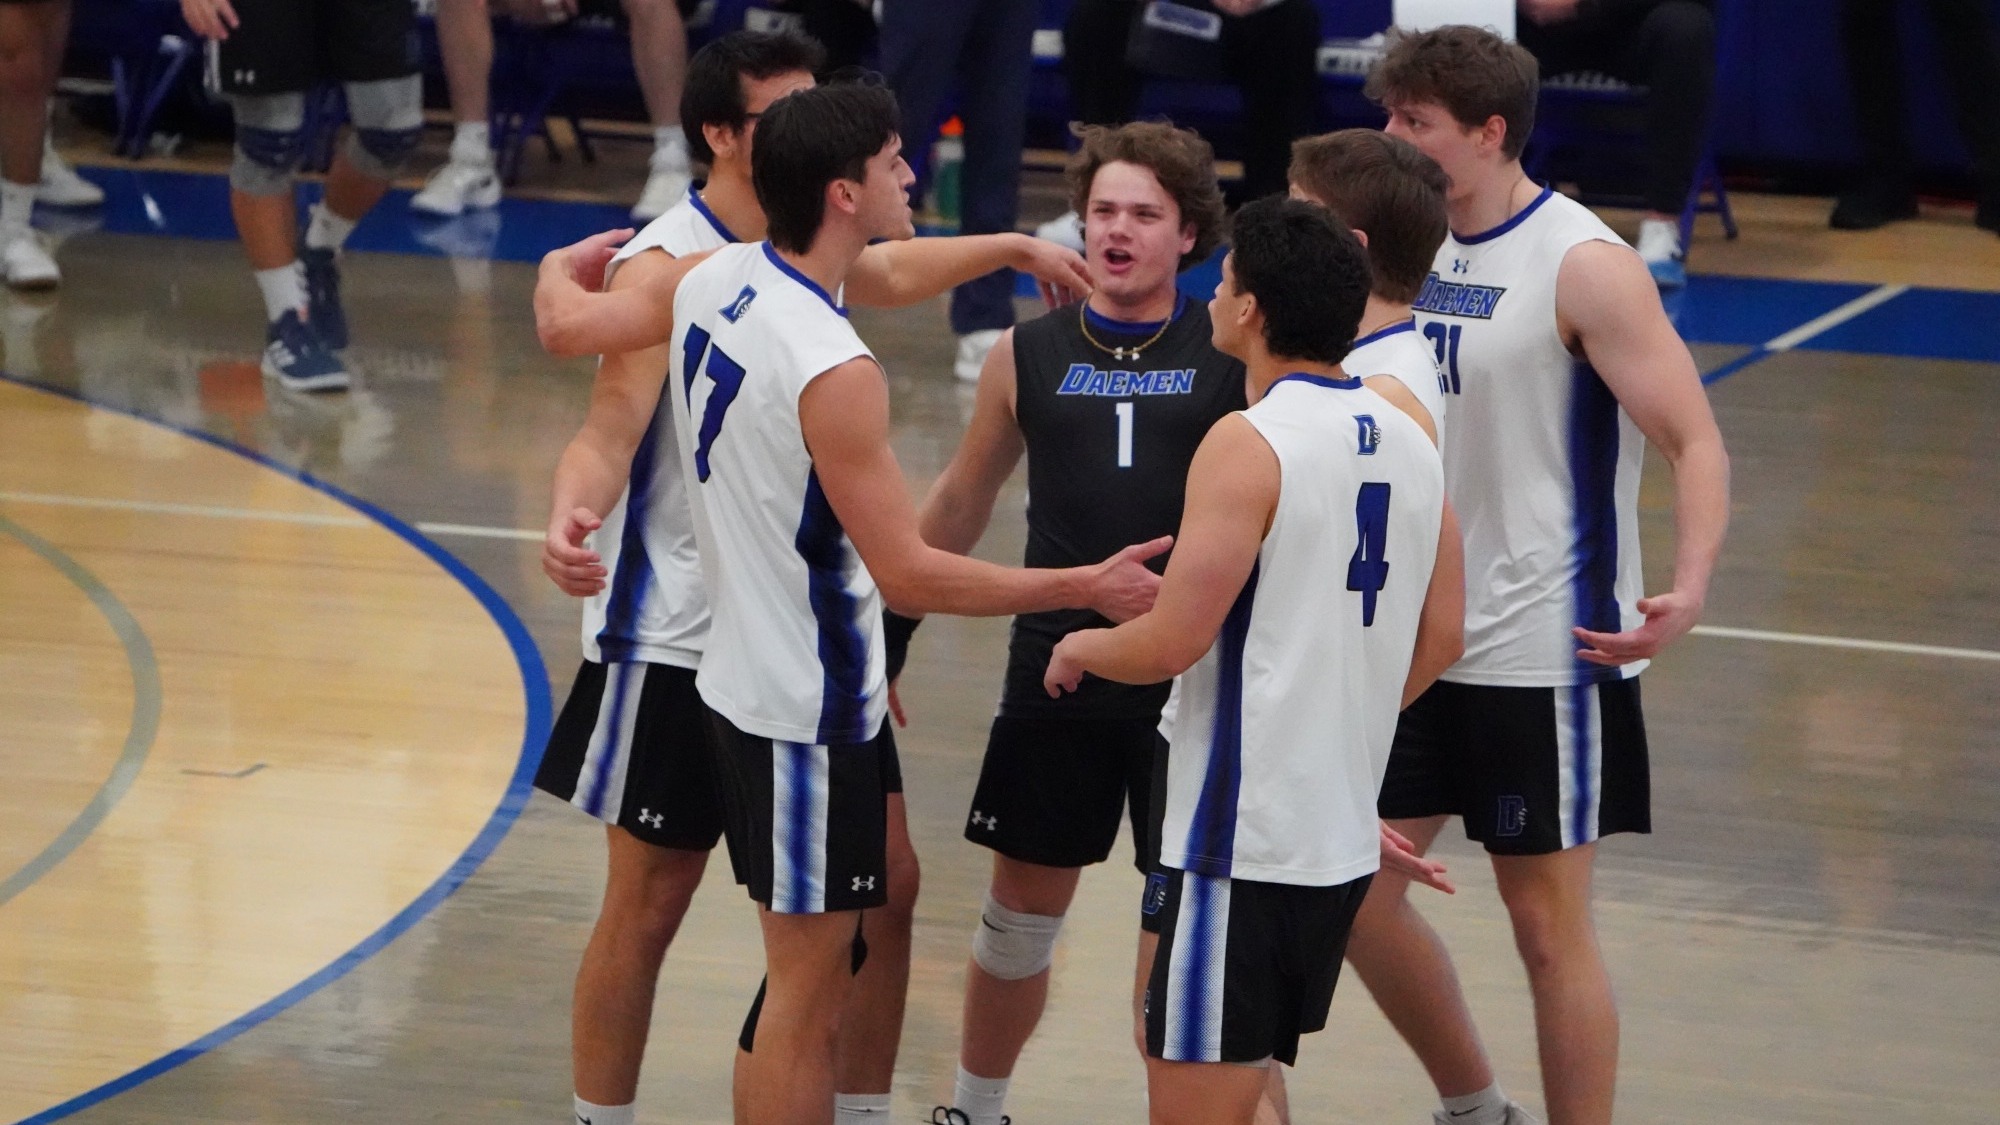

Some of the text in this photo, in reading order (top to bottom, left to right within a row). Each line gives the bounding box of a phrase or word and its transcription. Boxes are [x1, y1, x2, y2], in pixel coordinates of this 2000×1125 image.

[1411, 271, 1508, 320] DAEMEN
[683, 322, 746, 484] 17
[1056, 363, 1197, 397] DAEMEN
[1115, 402, 1134, 468] 1
[1346, 482, 1391, 627] 4
